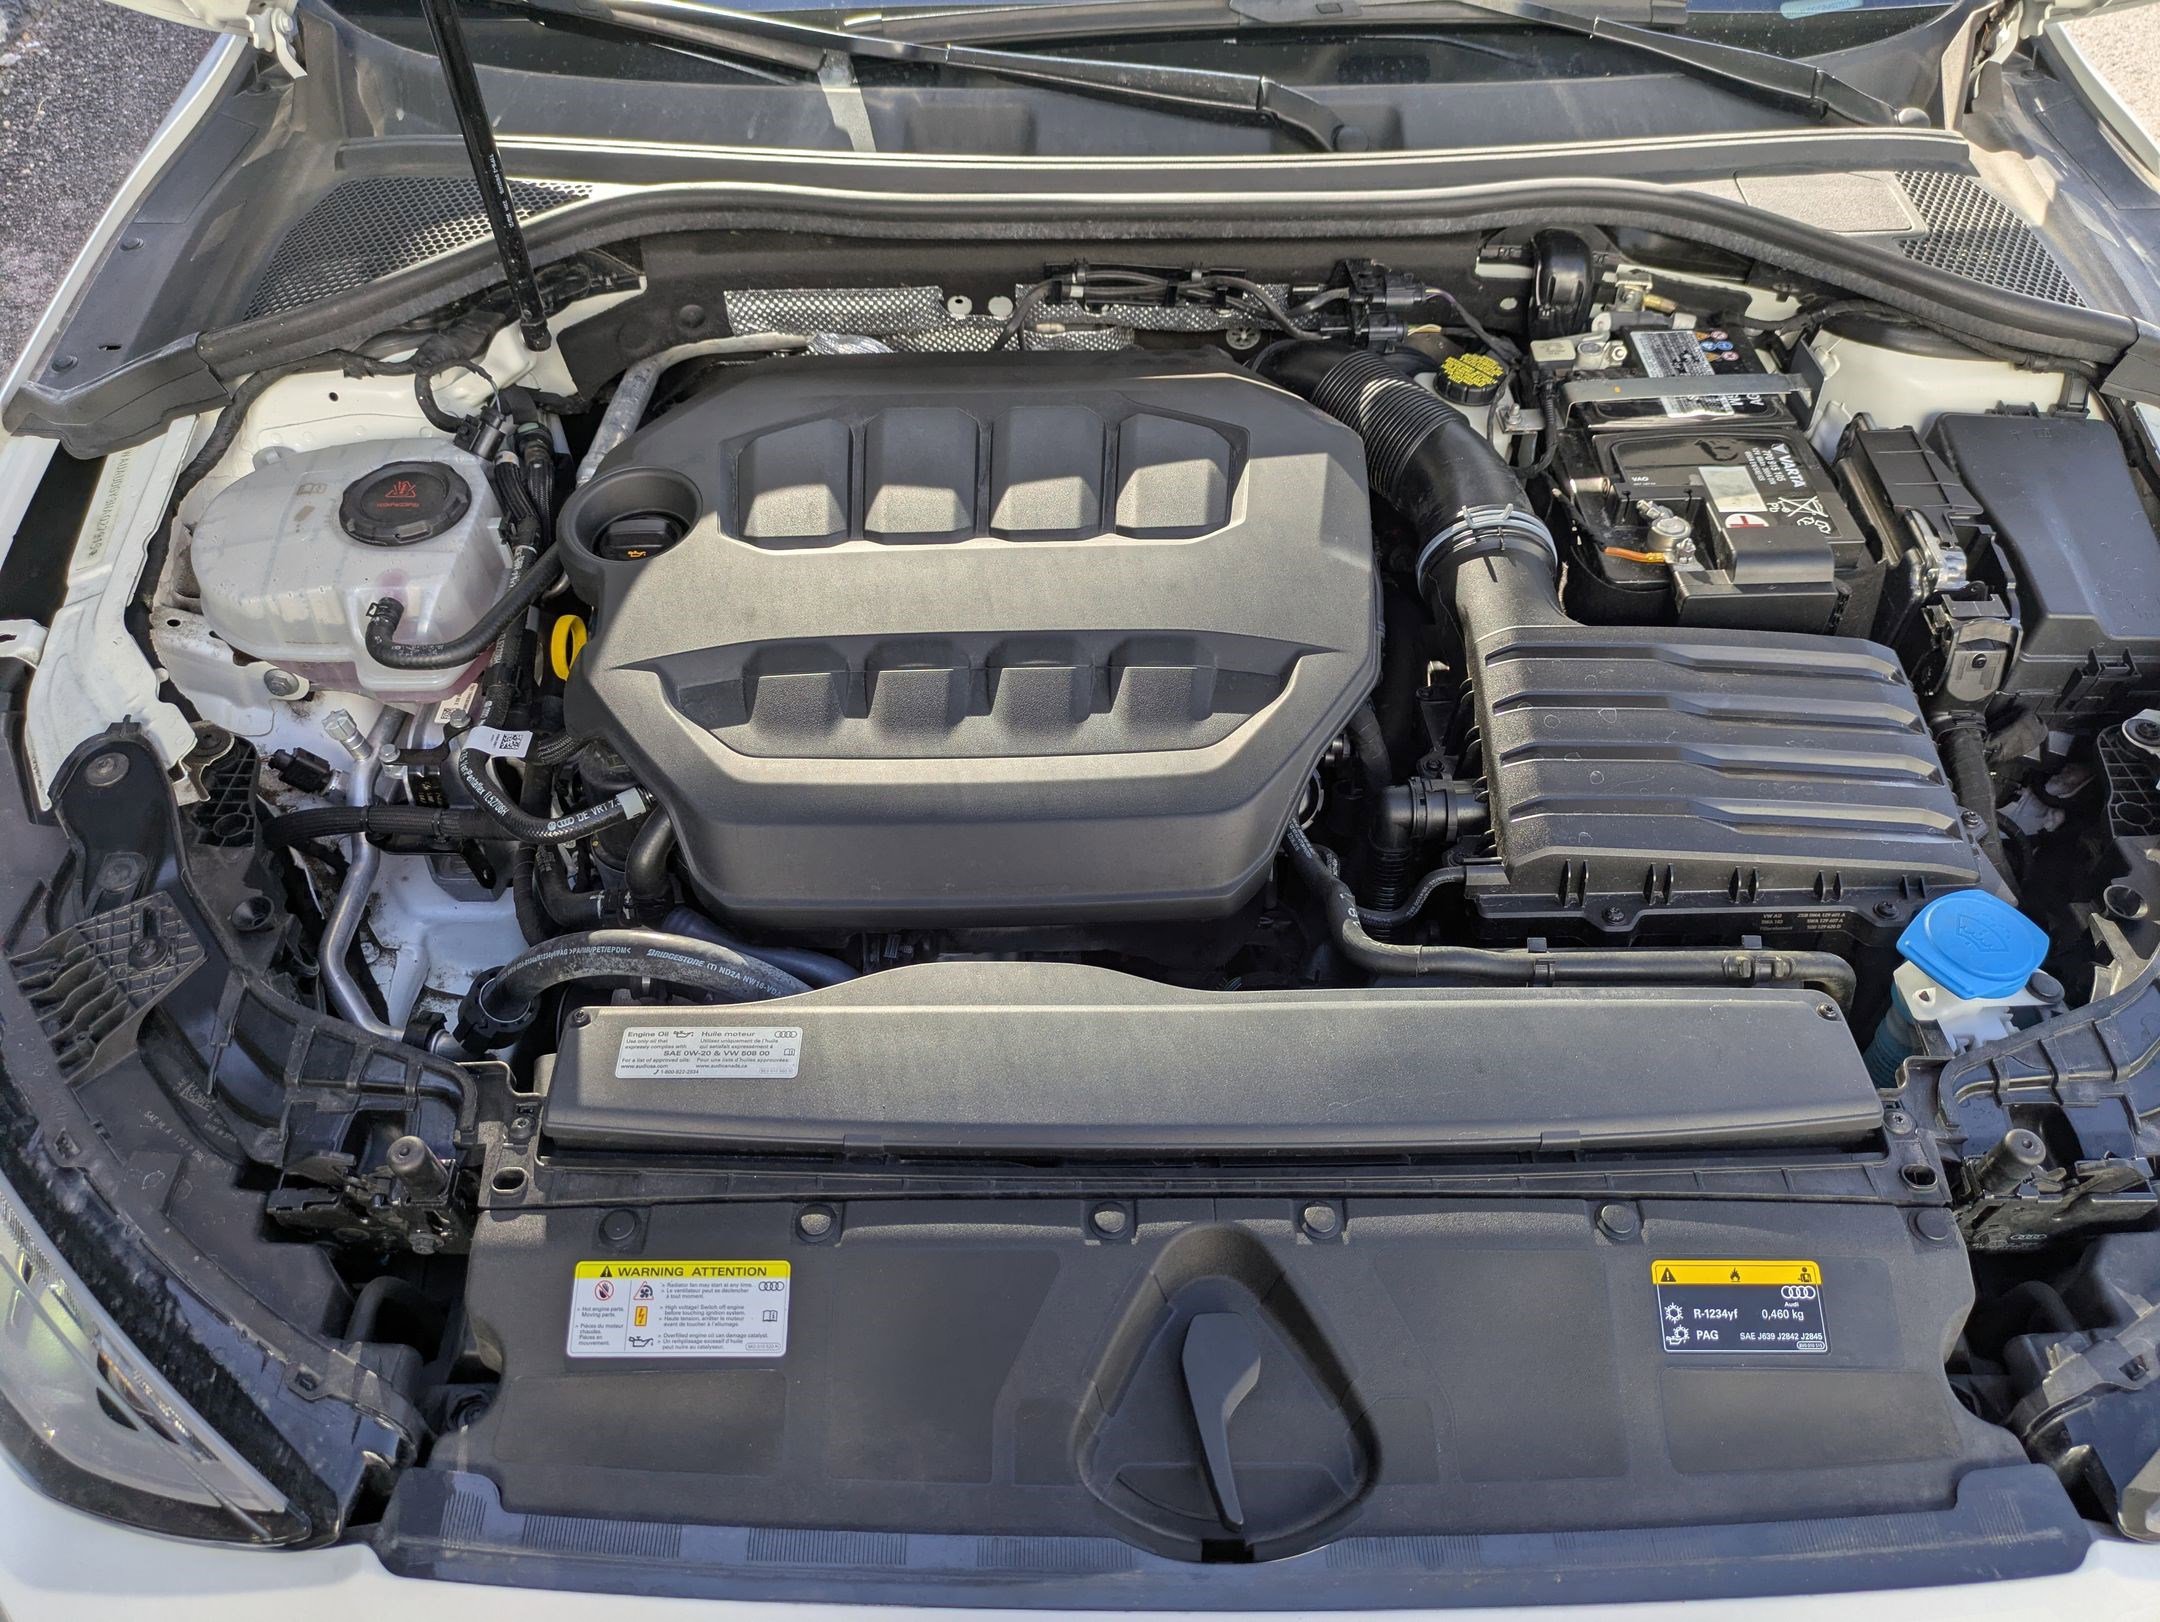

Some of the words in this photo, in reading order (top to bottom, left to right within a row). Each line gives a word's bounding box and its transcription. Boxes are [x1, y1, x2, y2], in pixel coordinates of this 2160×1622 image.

[1779, 455, 1806, 488] VARTA
[1767, 503, 1780, 513] Pb
[576, 810, 590, 822] DE
[590, 802, 608, 815] VRT
[646, 949, 706, 967] BRIDGESTONE
[719, 966, 742, 980] ND2A
[618, 1266, 684, 1277] WARNING
[691, 1266, 767, 1277] ATTENTION
[1693, 1308, 1738, 1321] R-1234yf
[1761, 1308, 1790, 1320] 0,460
[1792, 1309, 1805, 1321] kg
[1696, 1329, 1719, 1340] PAG
[1740, 1332, 1756, 1341] SAE
[1758, 1332, 1775, 1341] J639
[1777, 1332, 1799, 1341] J2842
[1801, 1332, 1823, 1341] J2845
